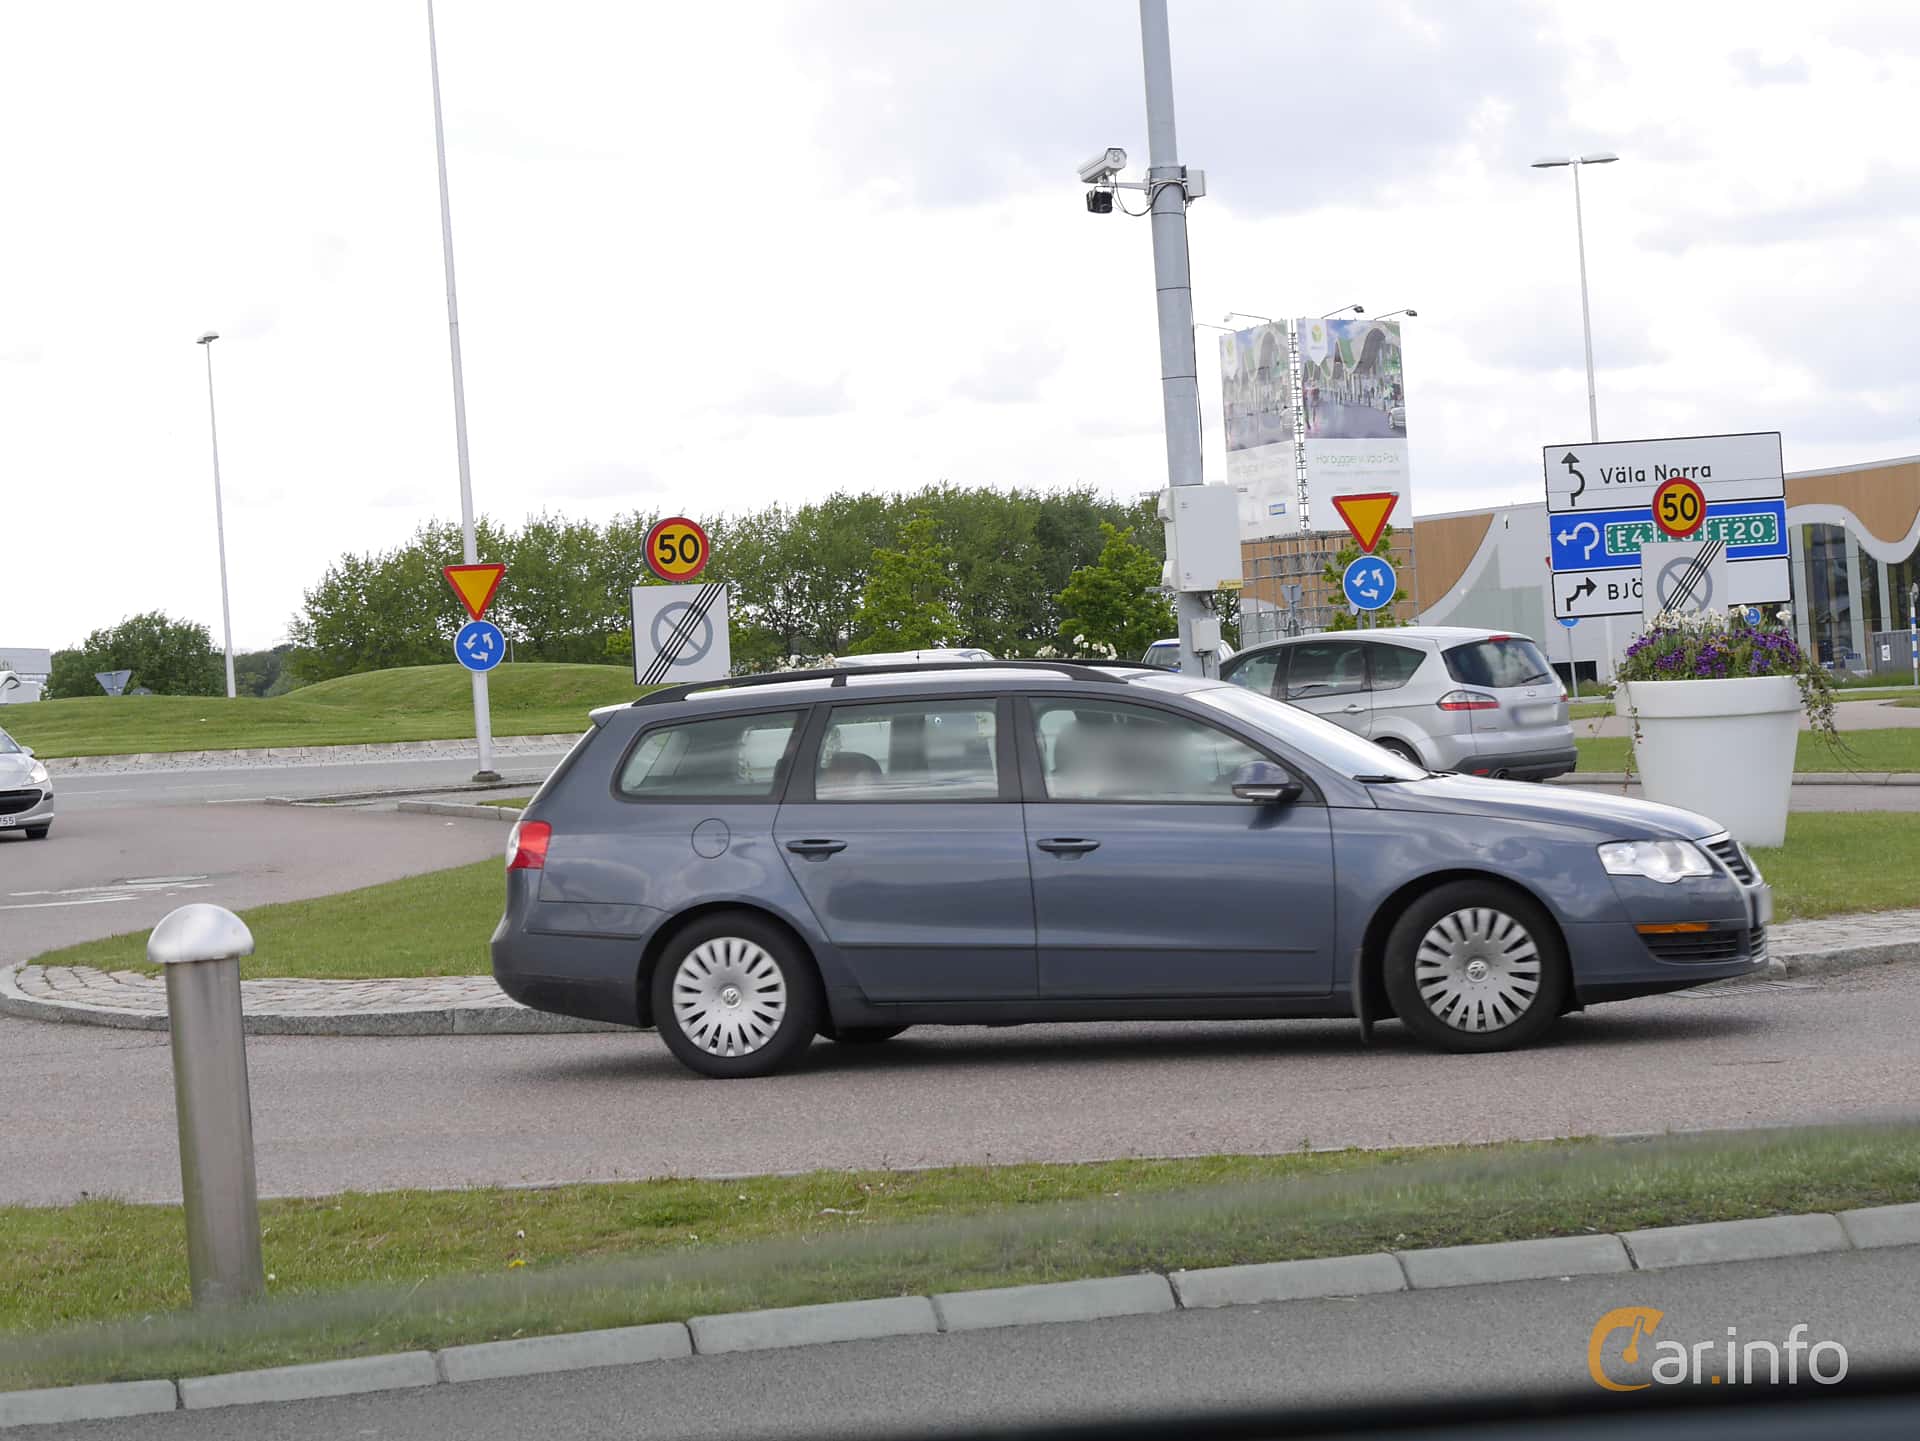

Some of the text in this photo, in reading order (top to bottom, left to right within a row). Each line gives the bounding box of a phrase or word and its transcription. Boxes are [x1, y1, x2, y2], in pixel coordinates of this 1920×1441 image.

[1600, 464, 1711, 484] Väla Norra
[1663, 492, 1698, 521] 50
[1616, 529, 1644, 547] E4
[1719, 521, 1765, 540] E20
[658, 533, 700, 564] 50
